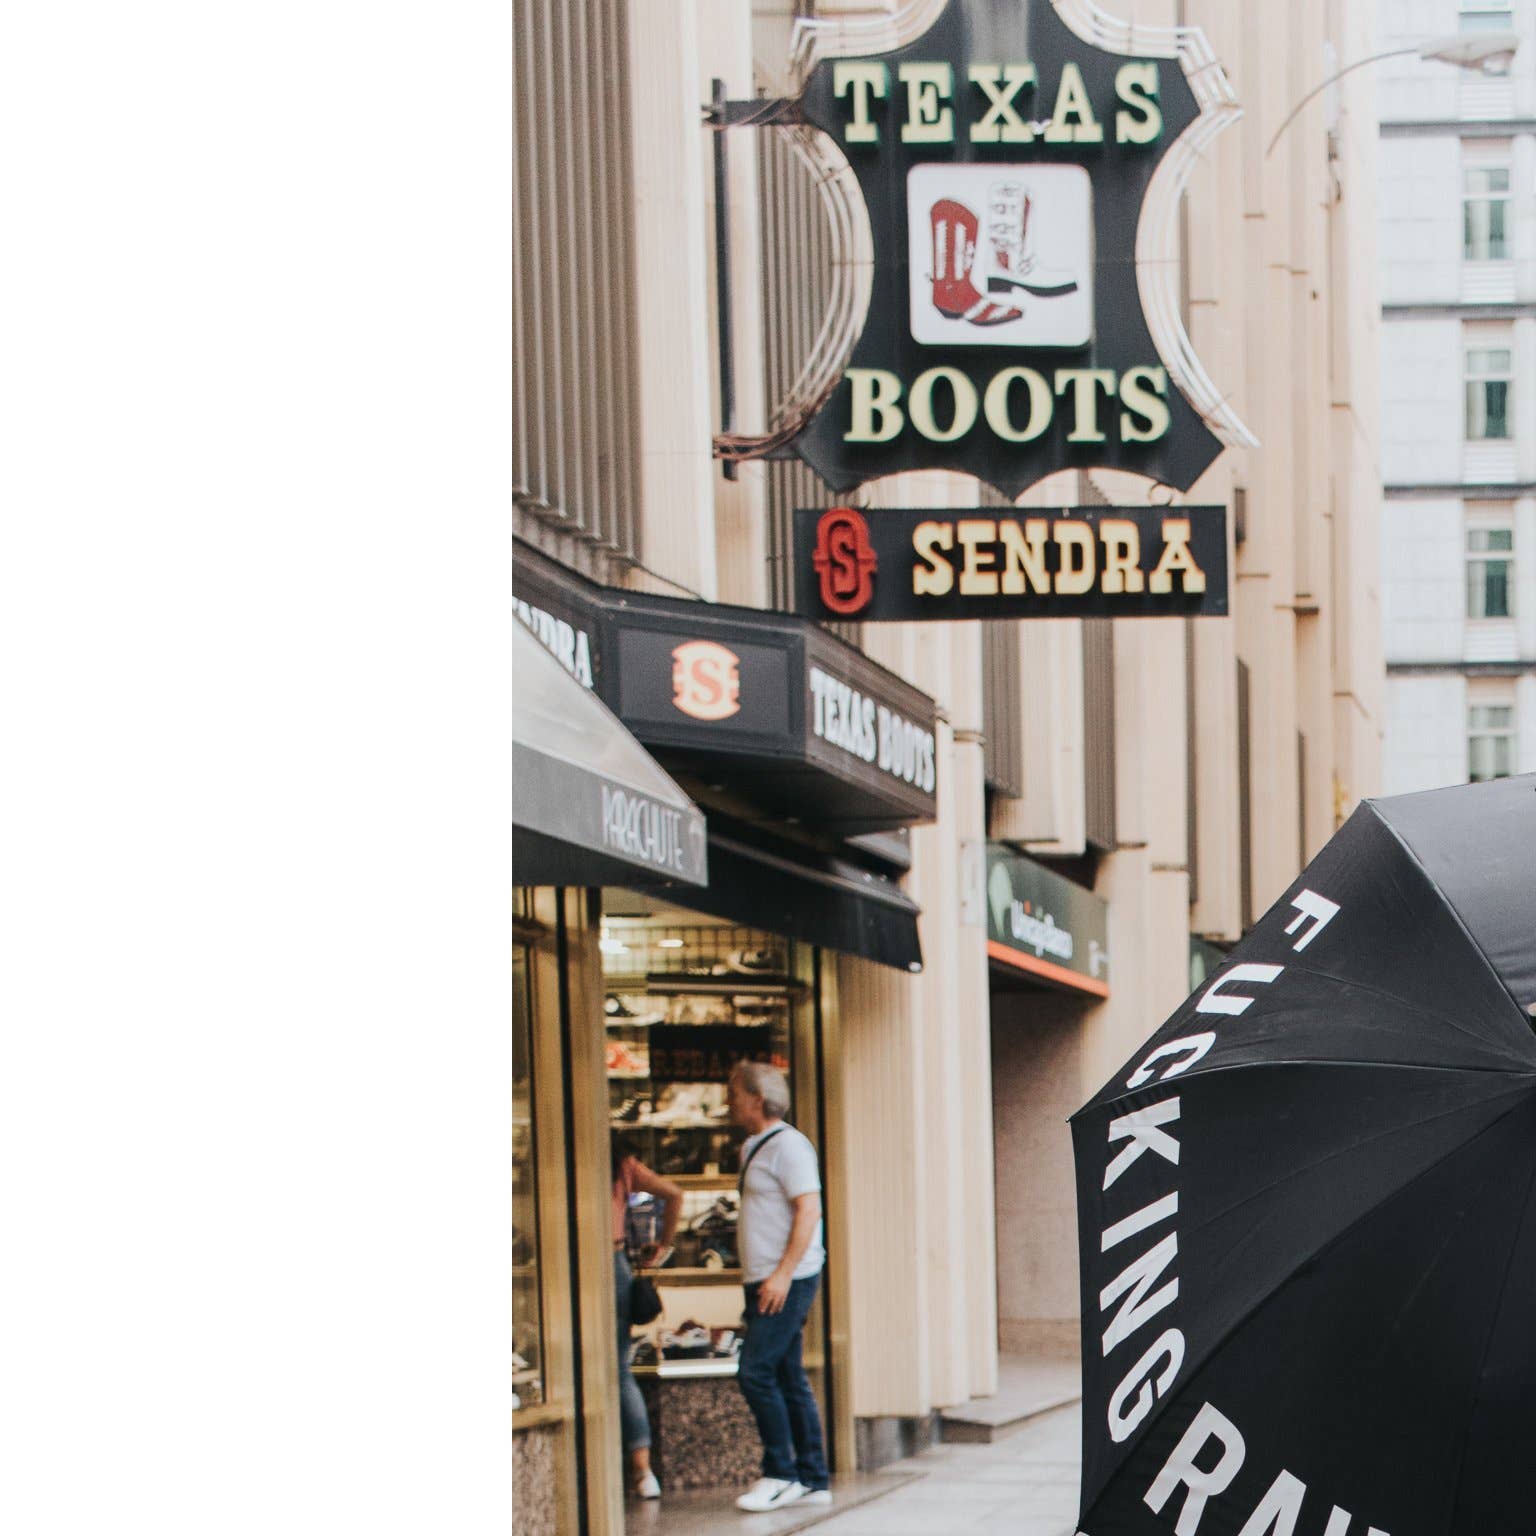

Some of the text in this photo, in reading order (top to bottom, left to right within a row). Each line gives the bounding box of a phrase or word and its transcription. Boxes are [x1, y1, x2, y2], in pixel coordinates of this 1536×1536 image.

[832, 60, 1165, 144] TEXAS
[843, 366, 1172, 442] BOOTS
[911, 518, 1206, 596] SENDRA
[809, 666, 936, 793] TEXAS BOOTS
[1100, 887, 1341, 1444] FUCKING
